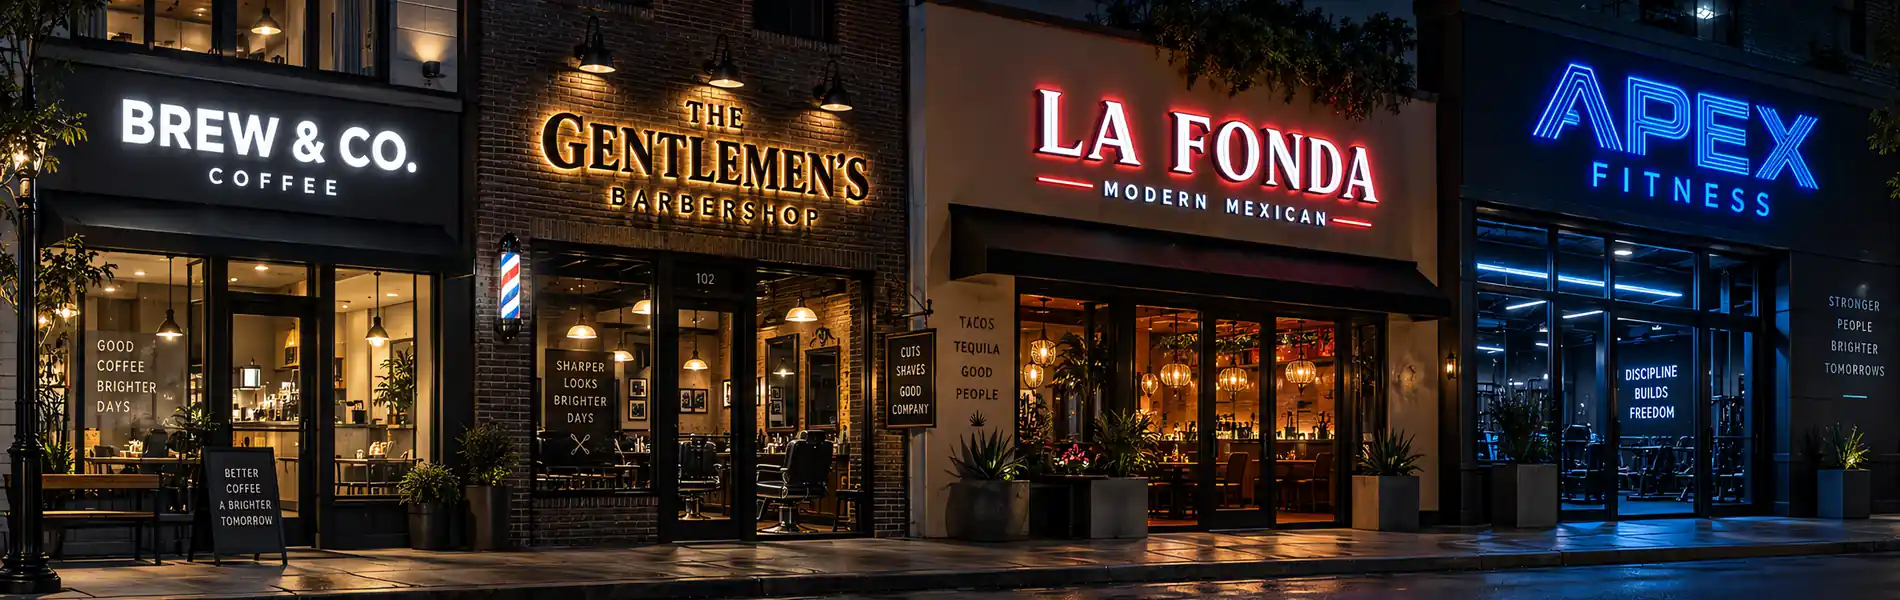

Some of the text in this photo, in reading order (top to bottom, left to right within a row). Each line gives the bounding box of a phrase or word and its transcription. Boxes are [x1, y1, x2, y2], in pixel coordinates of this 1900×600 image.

[685, 100, 744, 129] THE
[1533, 63, 1818, 190] APEX
[122, 98, 417, 173] BREW & CO.
[1035, 88, 1379, 204] LA FONDA
[542, 112, 869, 201] GENTLEMEN'S
[208, 167, 337, 196] COFFEE
[1592, 160, 1770, 217] FITNESS
[611, 187, 819, 227] BARBERSHOP
[1103, 181, 1326, 227] MODERN MEXICAN
[696, 273, 715, 285] 102
[1828, 296, 1880, 312] STRONGER
[959, 316, 994, 329] TACOS
[1837, 318, 1873, 333] PEOPLE
[97, 339, 134, 352] GOOD
[900, 346, 920, 358] CUTS
[954, 341, 1000, 355] TEQUILA
[1831, 340, 1879, 355] BRIGHTER
[97, 360, 144, 373] COFFEE
[556, 360, 605, 373] SHARPER
[896, 364, 925, 376] SHAVES
[961, 365, 992, 378] GOOD
[1625, 364, 1678, 381] DISCIPLINE
[1825, 362, 1885, 377] TOMORROWS
[97, 379, 156, 393] BRIGHTER
[563, 377, 598, 389] LOOKS
[899, 385, 922, 397] GOOD
[956, 388, 998, 400] PEOPLE
[1634, 386, 1668, 399] BUILDS
[97, 399, 130, 413] DAYS
[553, 394, 607, 407] BRIGHTER
[892, 403, 929, 415] COMPANY
[1629, 405, 1675, 419] FREEDOM
[567, 412, 594, 424] DAYS
[224, 468, 259, 479] BETTER
[226, 482, 261, 494] COFFEE
[219, 499, 272, 510] A BRIGHTER
[220, 515, 273, 526] TOMORROW
